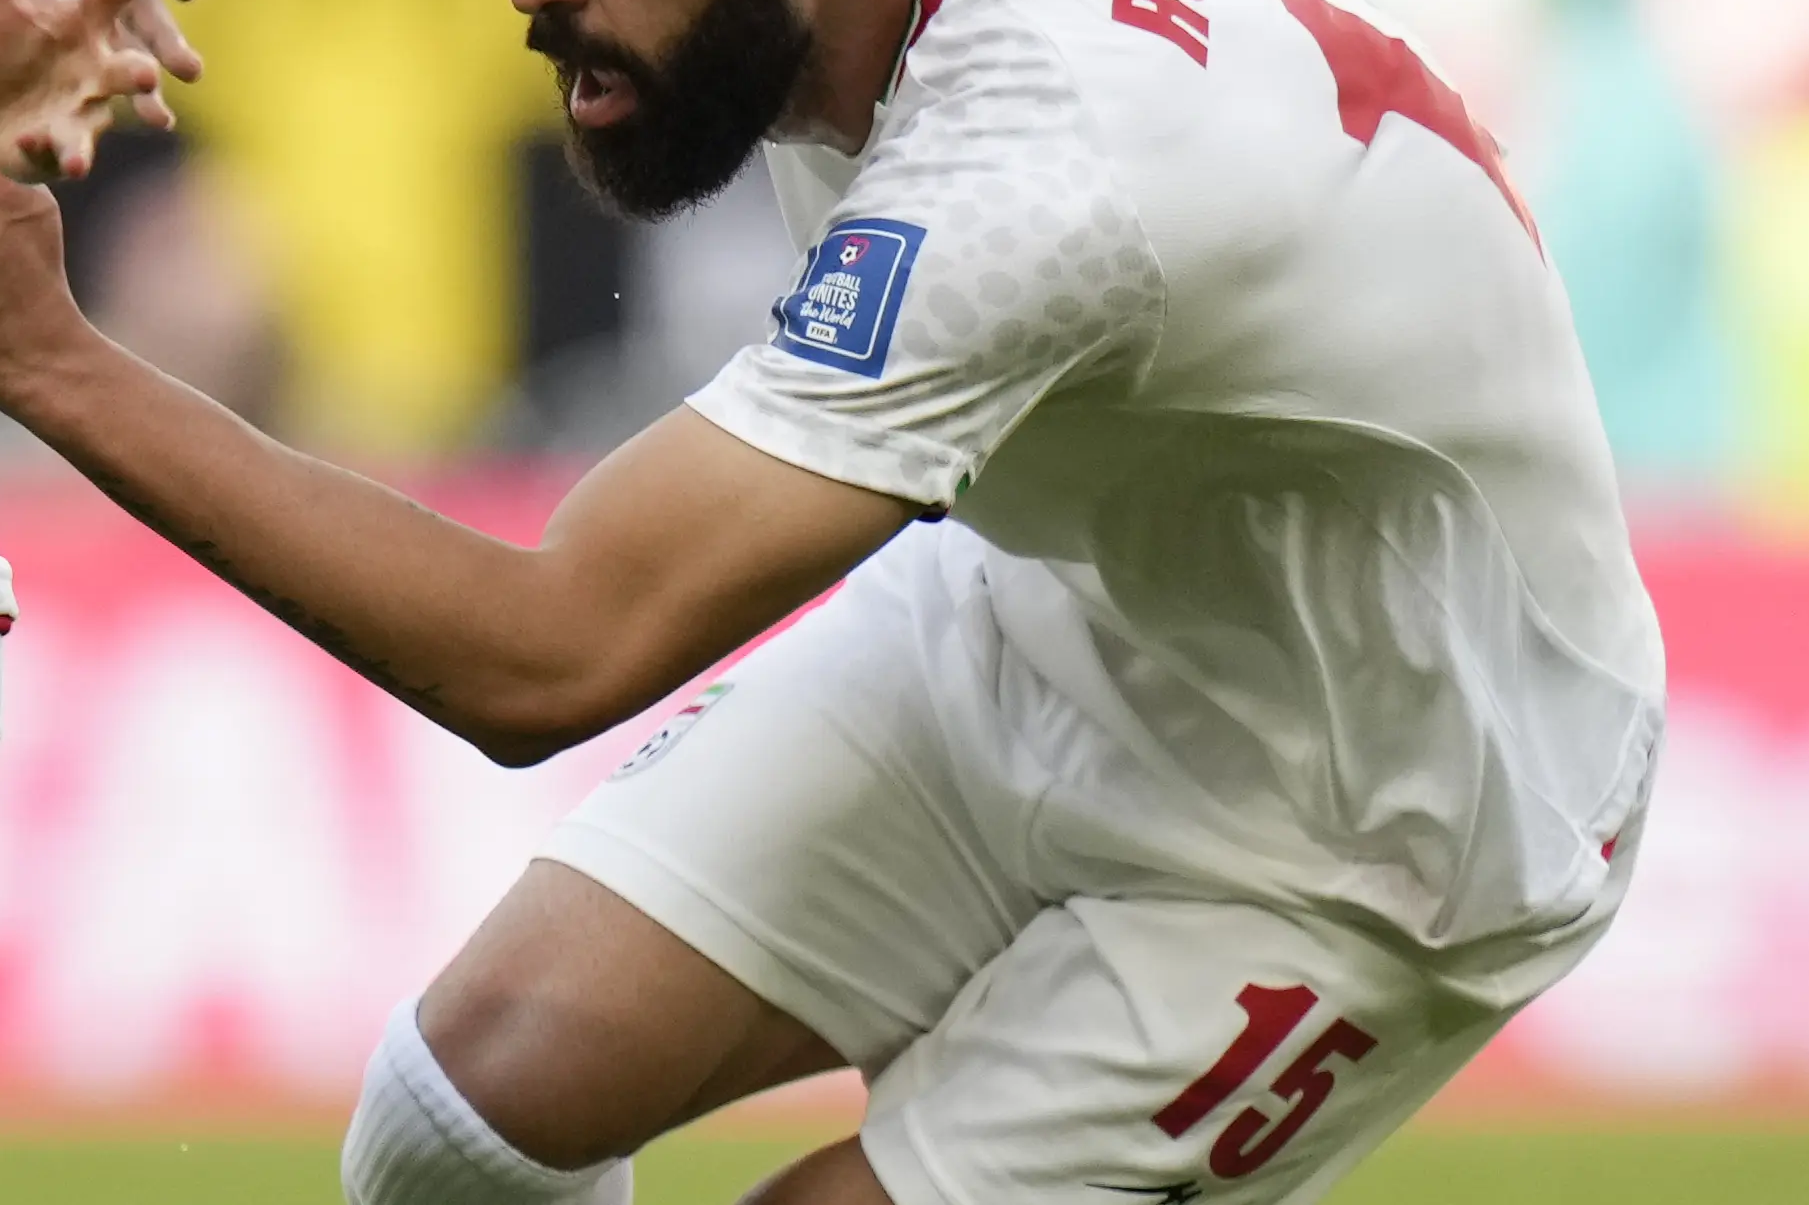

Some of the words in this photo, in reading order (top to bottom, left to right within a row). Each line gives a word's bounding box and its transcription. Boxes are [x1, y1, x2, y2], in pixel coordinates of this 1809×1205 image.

[808, 283, 858, 311] UNITES
[810, 327, 831, 338] FIFA
[1150, 982, 1379, 1180] 15
